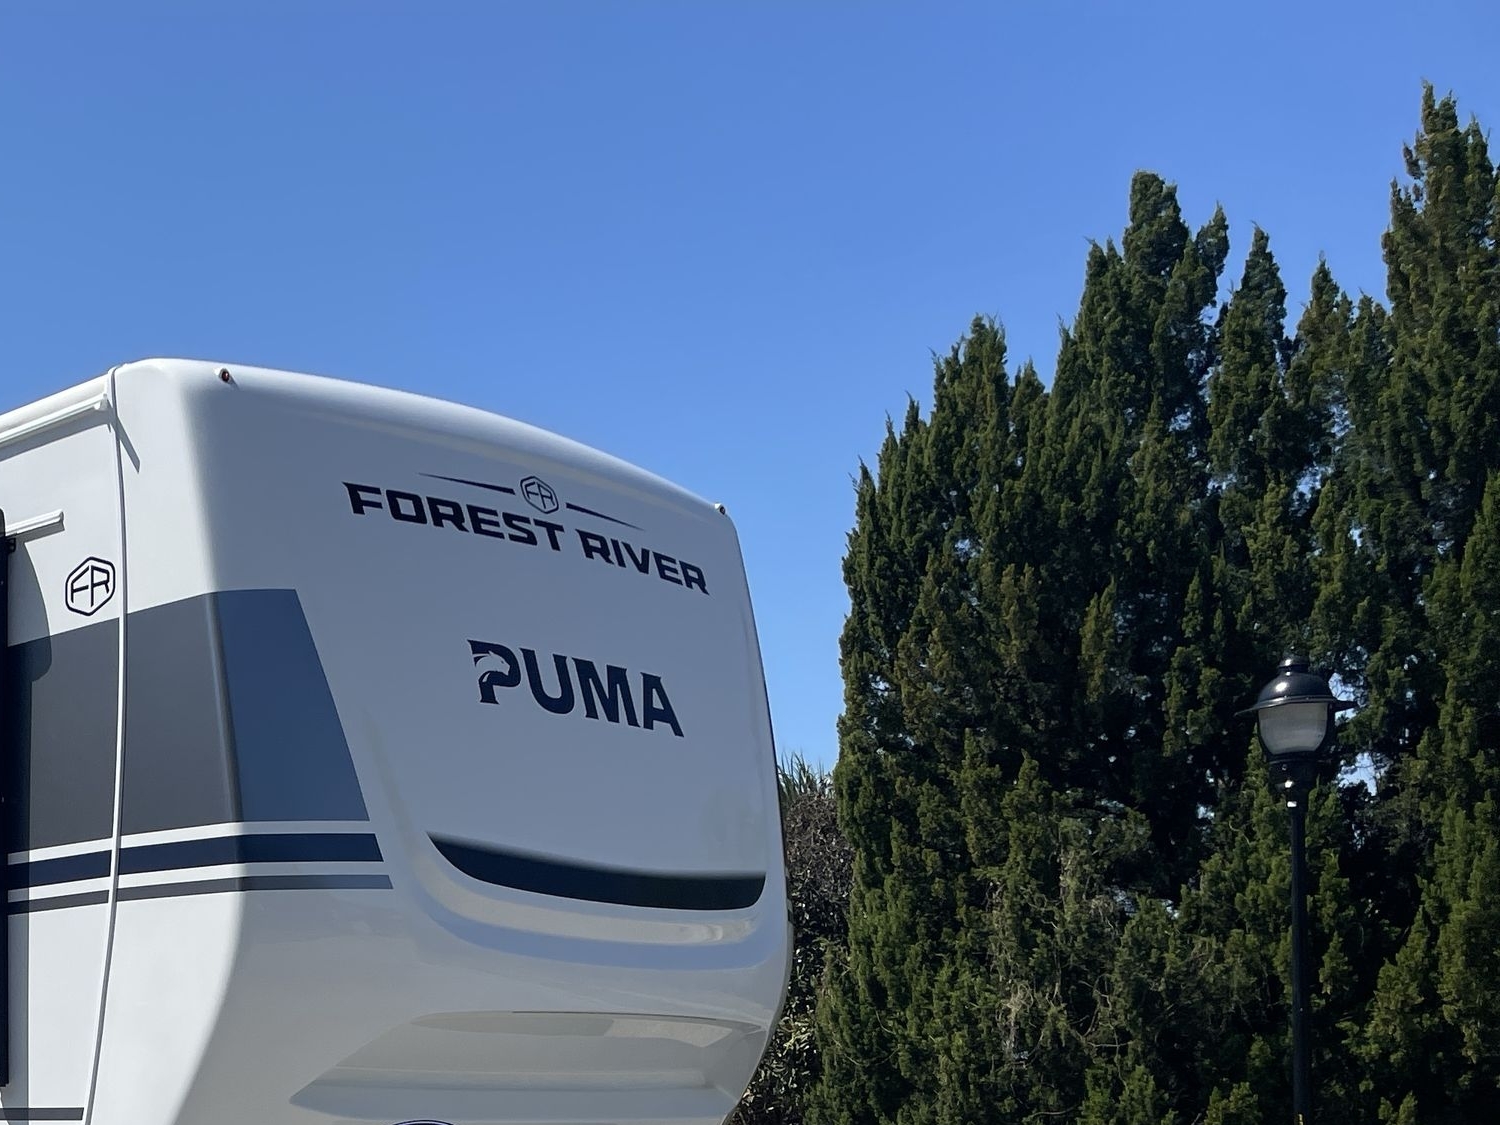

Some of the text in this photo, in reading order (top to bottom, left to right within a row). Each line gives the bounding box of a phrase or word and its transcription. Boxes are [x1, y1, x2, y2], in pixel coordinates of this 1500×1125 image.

[342, 482, 710, 595] FOREST RIVER
[467, 639, 685, 738] PUMA
